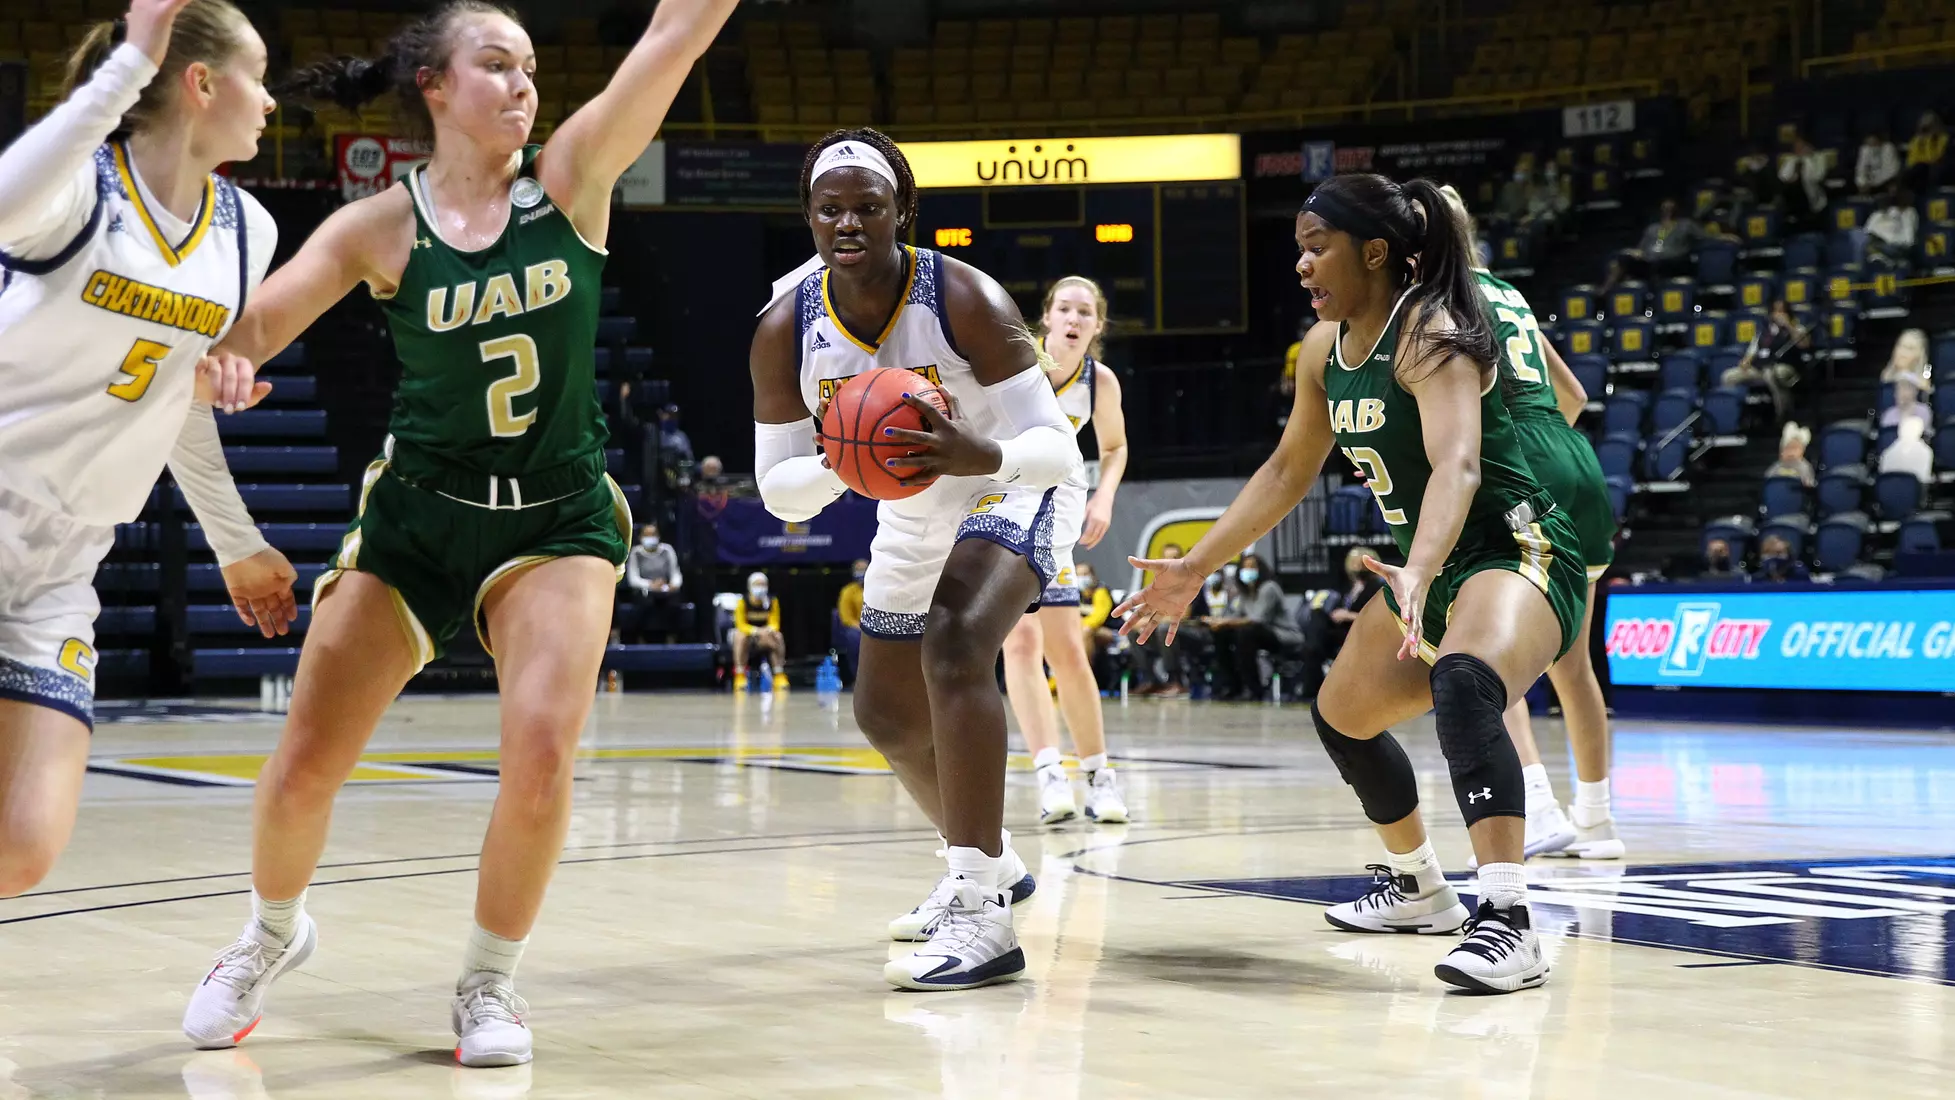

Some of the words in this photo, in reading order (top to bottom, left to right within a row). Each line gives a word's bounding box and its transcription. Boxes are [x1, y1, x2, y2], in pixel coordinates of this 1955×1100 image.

[1576, 106, 1622, 129] 112
[828, 154, 861, 164] adidas
[977, 144, 1088, 182] unum
[935, 228, 972, 247] UTC
[427, 259, 572, 333] UAB
[811, 340, 832, 353] adidas
[106, 338, 174, 403] 5
[479, 333, 541, 438] 2
[1605, 618, 1674, 659] FOOD
[1707, 618, 1772, 660] CITY
[1780, 620, 1917, 659] OFFICIAL
